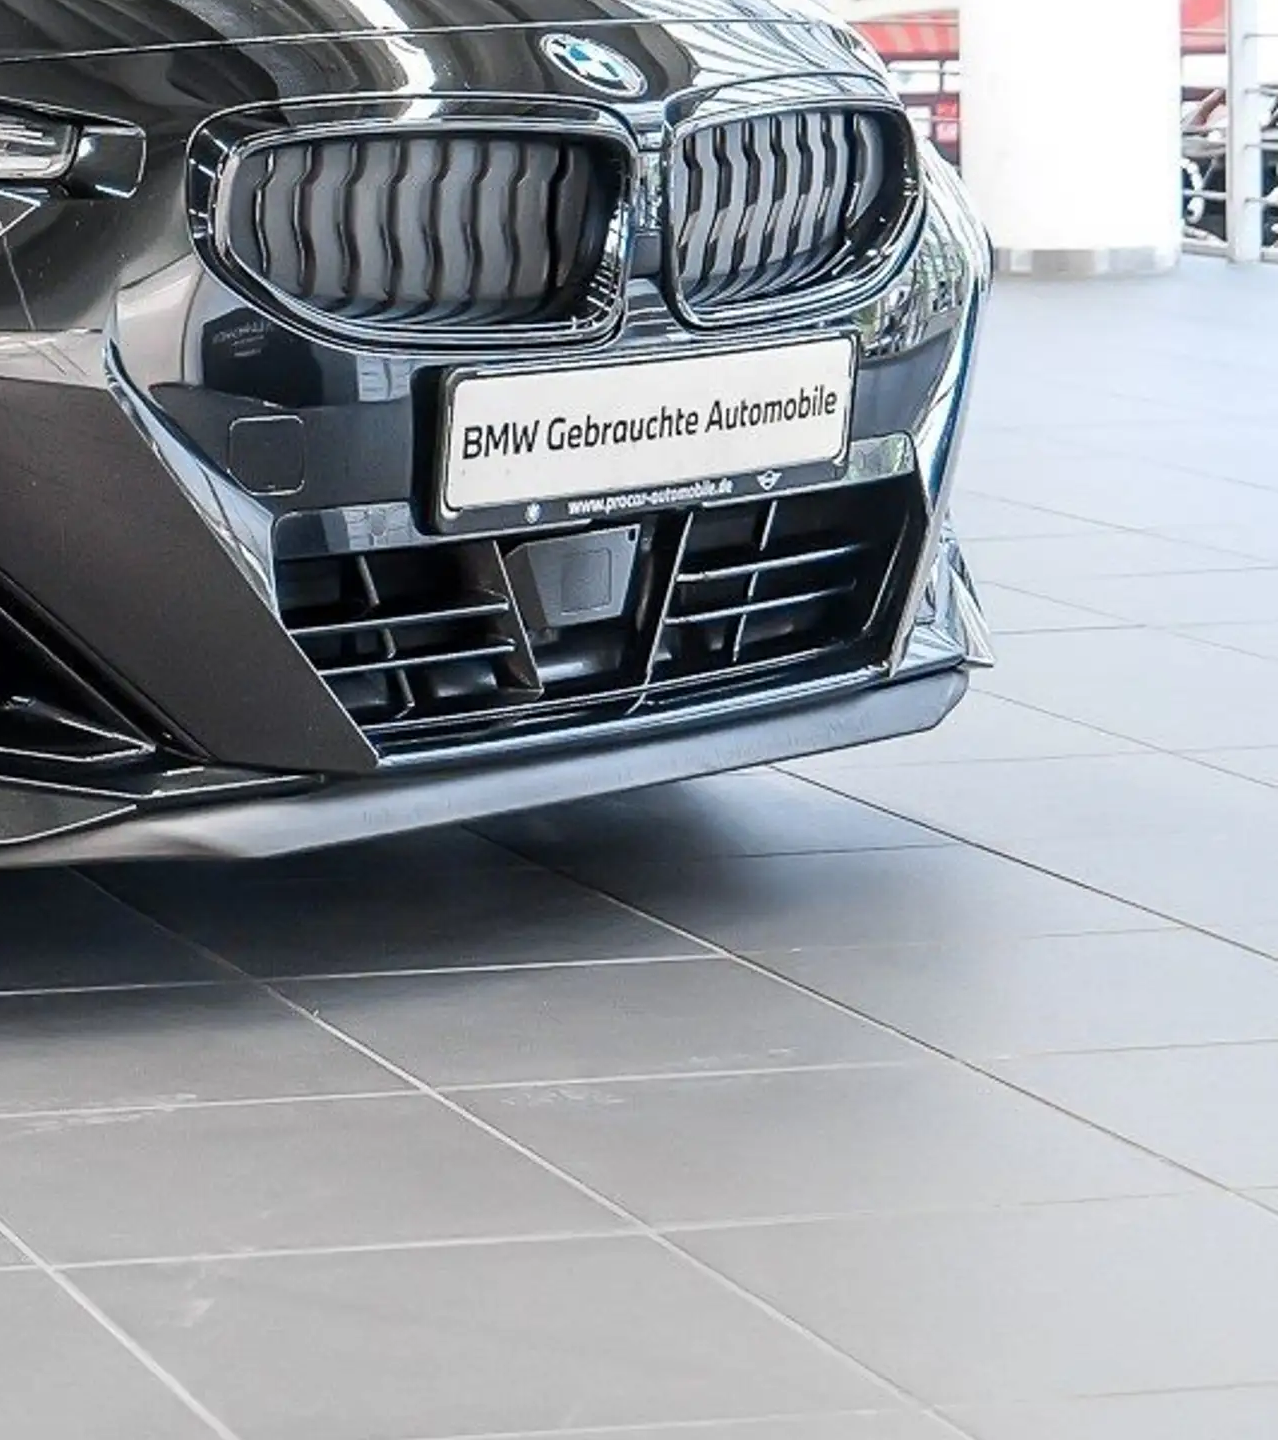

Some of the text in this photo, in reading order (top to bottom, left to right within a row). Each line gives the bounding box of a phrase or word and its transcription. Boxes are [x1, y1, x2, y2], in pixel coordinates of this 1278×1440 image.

[461, 385, 838, 460] BMW Gebrauchte Automobile
[567, 478, 735, 515] www.procar-automobile.de
